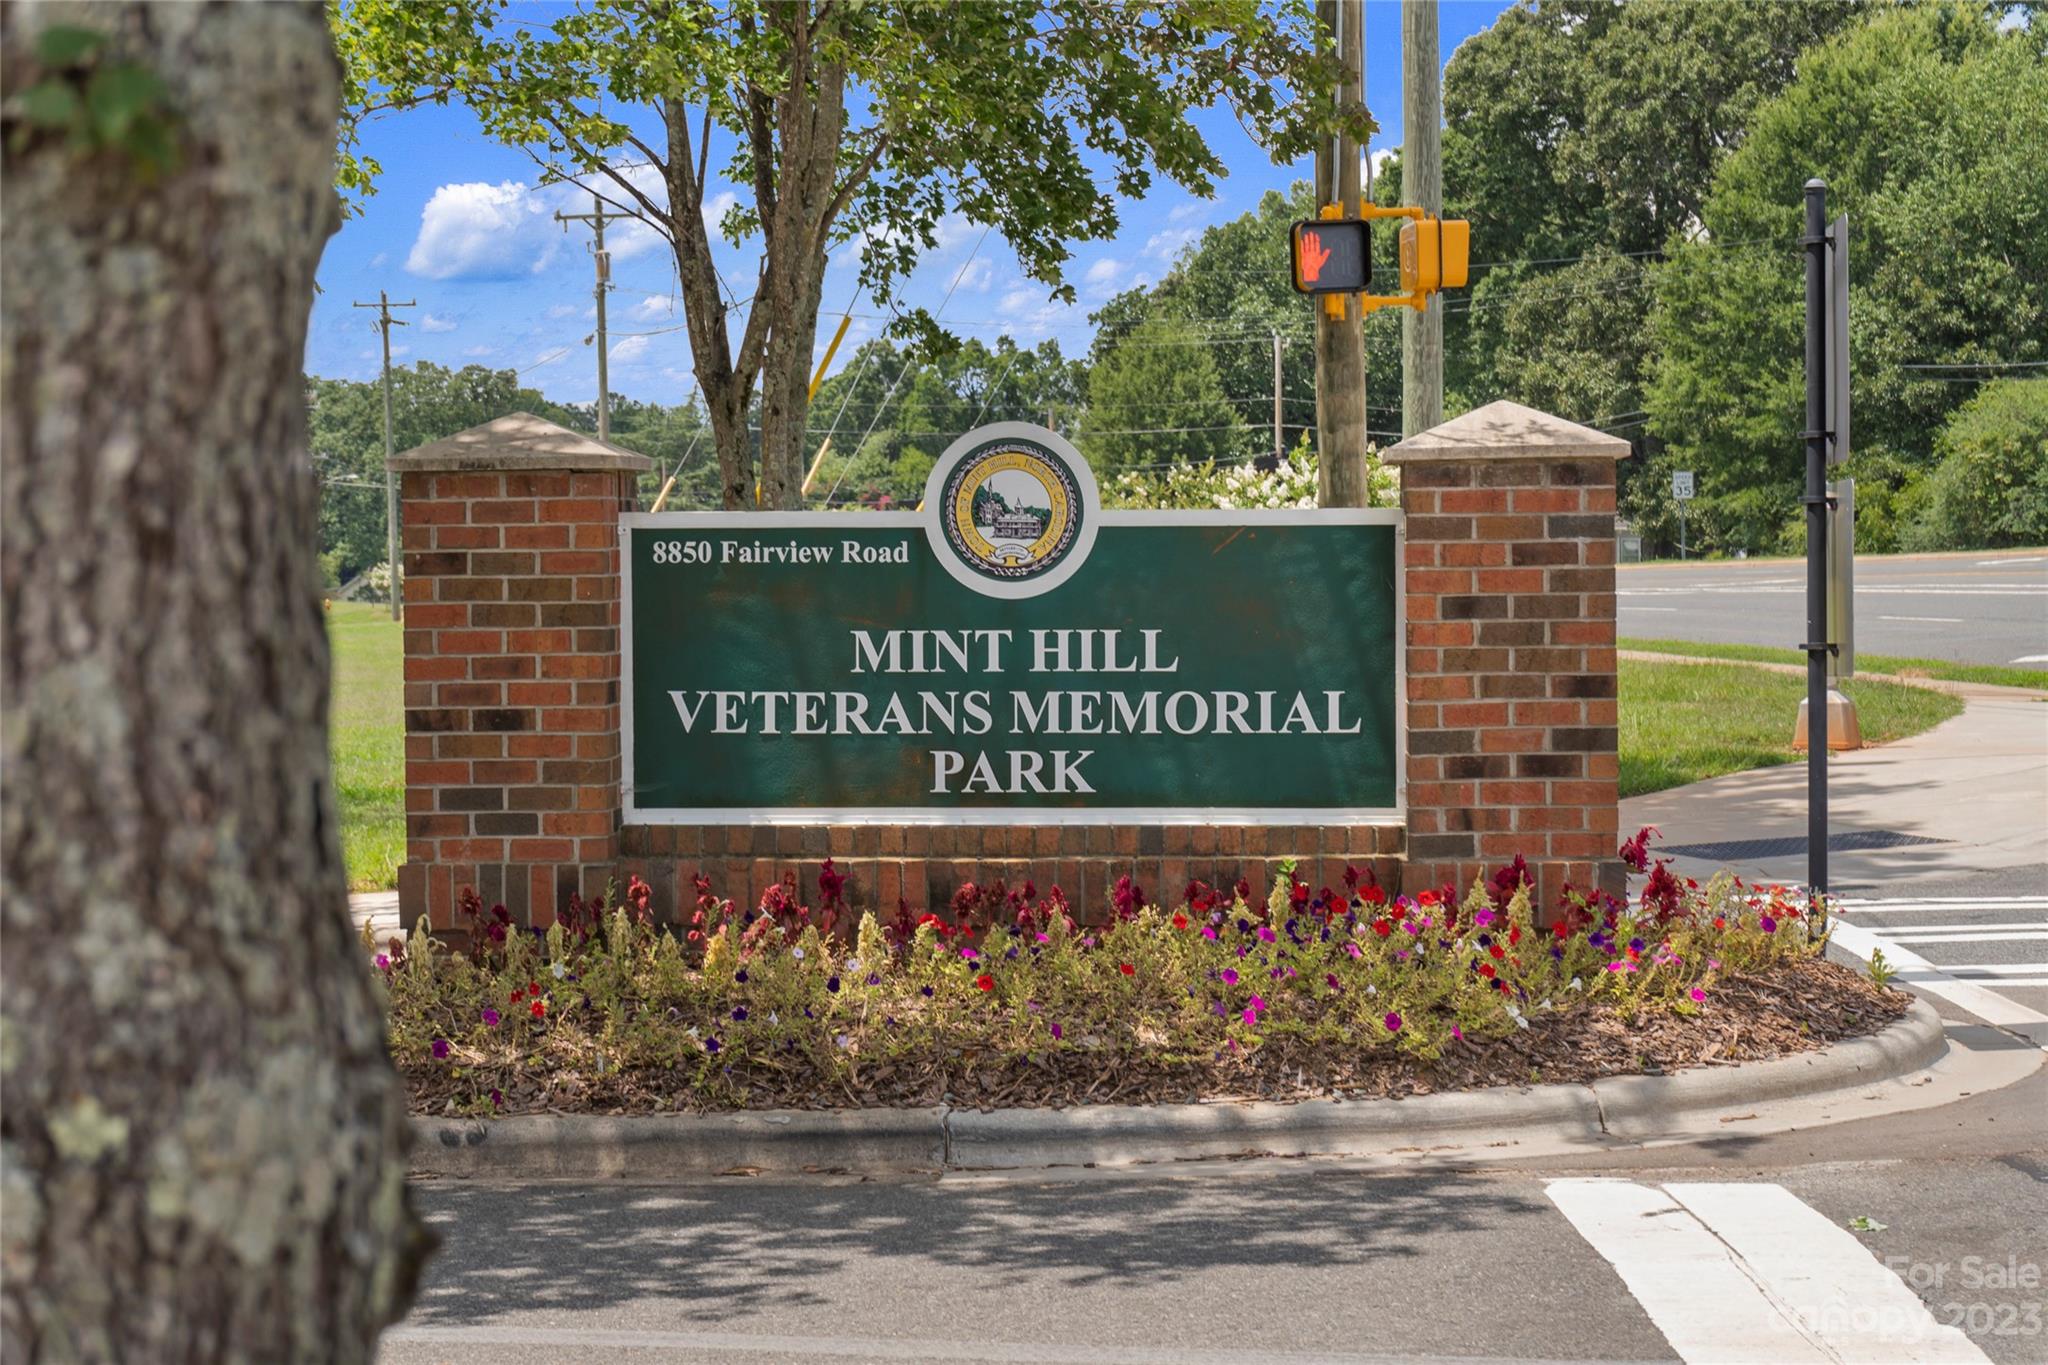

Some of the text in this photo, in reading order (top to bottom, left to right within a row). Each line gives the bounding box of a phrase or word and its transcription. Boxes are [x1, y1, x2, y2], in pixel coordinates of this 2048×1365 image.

[1675, 486, 1692, 497] 35
[652, 540, 909, 564] 8850 Fairview Road
[851, 629, 1179, 673] MINT HILL
[667, 690, 1362, 735] VETERANS MEMORIAL
[929, 750, 1097, 793] PARK
